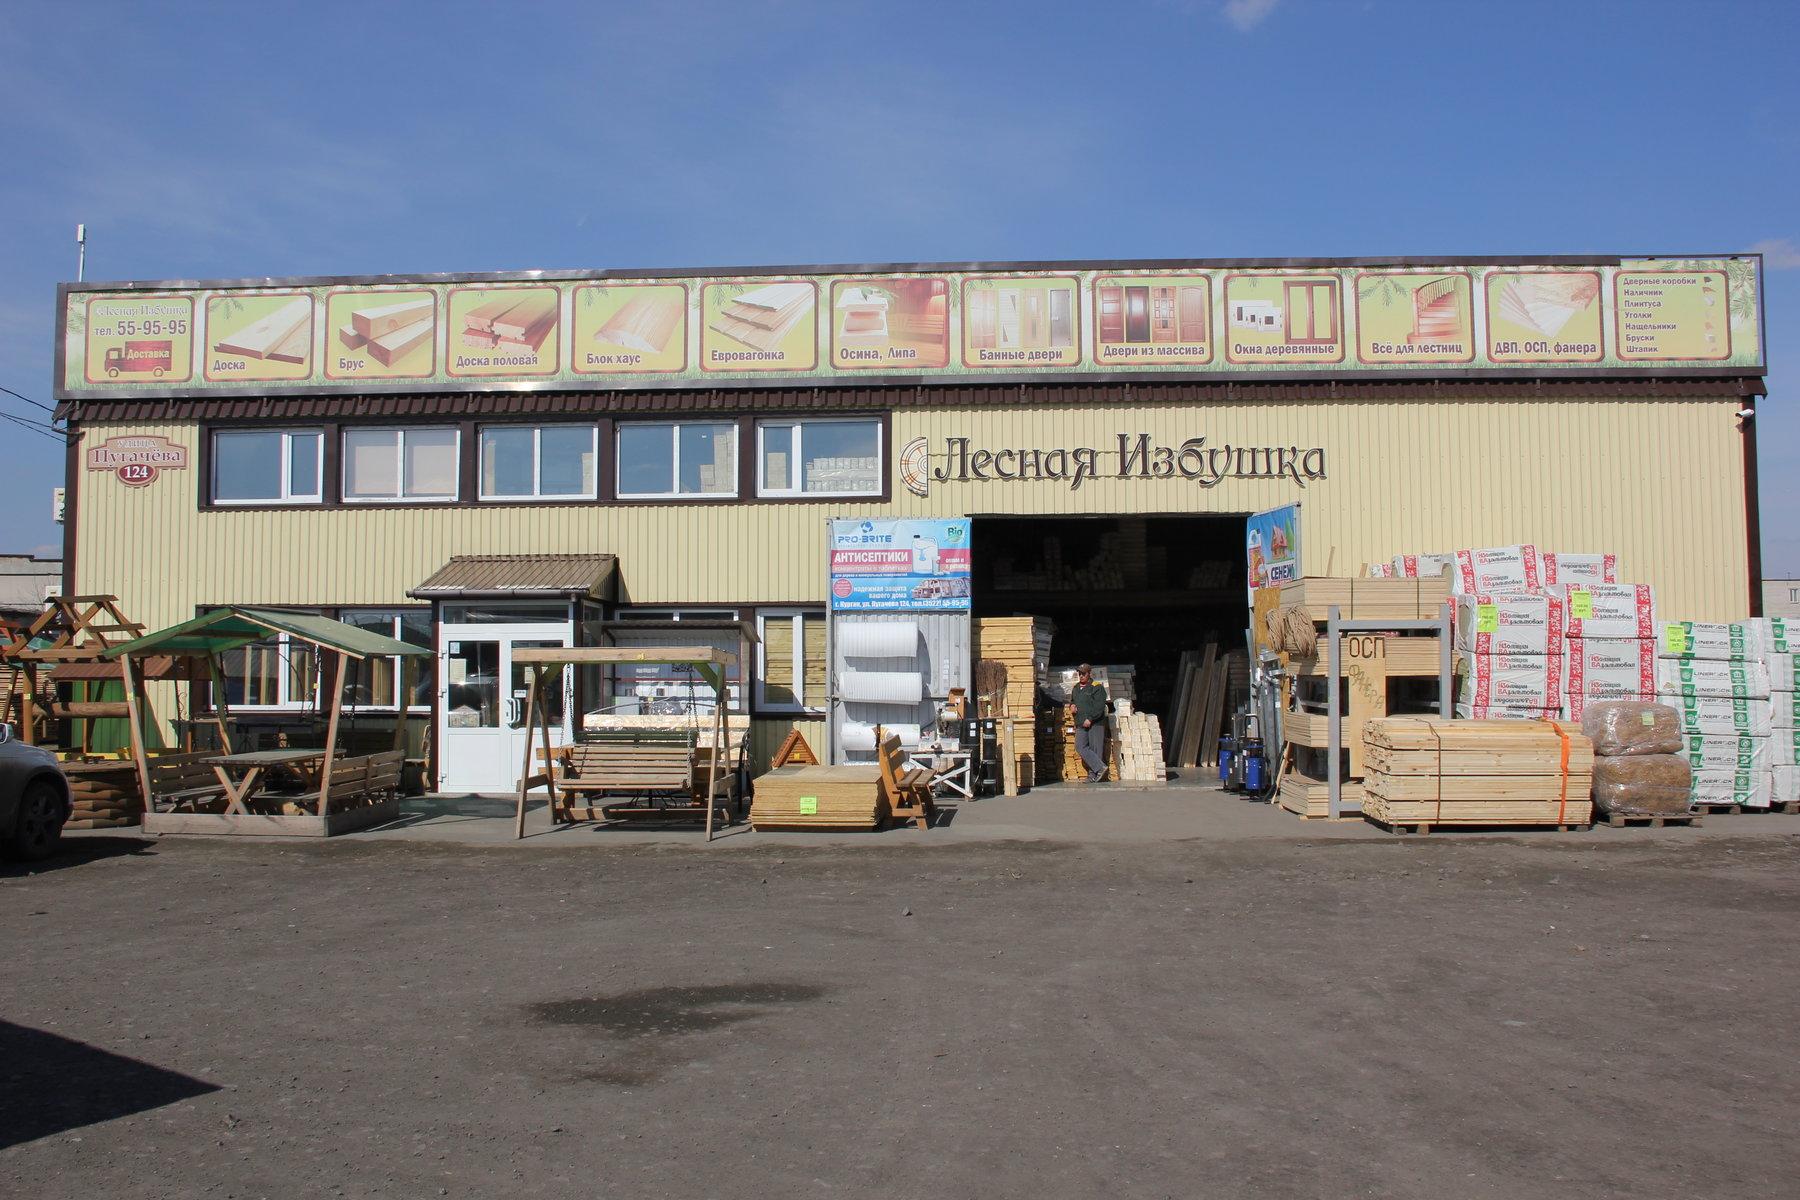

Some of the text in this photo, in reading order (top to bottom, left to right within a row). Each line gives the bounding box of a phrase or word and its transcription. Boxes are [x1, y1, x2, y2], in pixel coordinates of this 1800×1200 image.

[95, 320, 186, 336] тел. 55-95-95
[1626, 334, 1654, 342] Бруски
[127, 350, 170, 360] Доставка
[840, 348, 916, 362] Осина, Липа
[1104, 346, 1204, 358] Двери из массива
[1234, 344, 1334, 356] Окна деревянные
[1372, 341, 1462, 356] Всё для лестниц
[1494, 342, 1596, 356] ДВП, ОСП, фанера
[456, 354, 538, 367] Доска половая
[586, 353, 640, 366] Блок хаус
[711, 350, 784, 362] Евровагонка
[979, 349, 1062, 362] Банные двери
[213, 359, 246, 372] Доска
[339, 358, 364, 371] Брус
[94, 449, 181, 466] Пугачёва
[934, 433, 1328, 490] Лесная Избушка
[124, 466, 148, 478] 124
[838, 535, 892, 543] PRO-BRITE
[948, 528, 962, 537] Bio
[834, 552, 908, 562] АНТИСЕПТИКИ
[1350, 637, 1386, 658] ОСП
